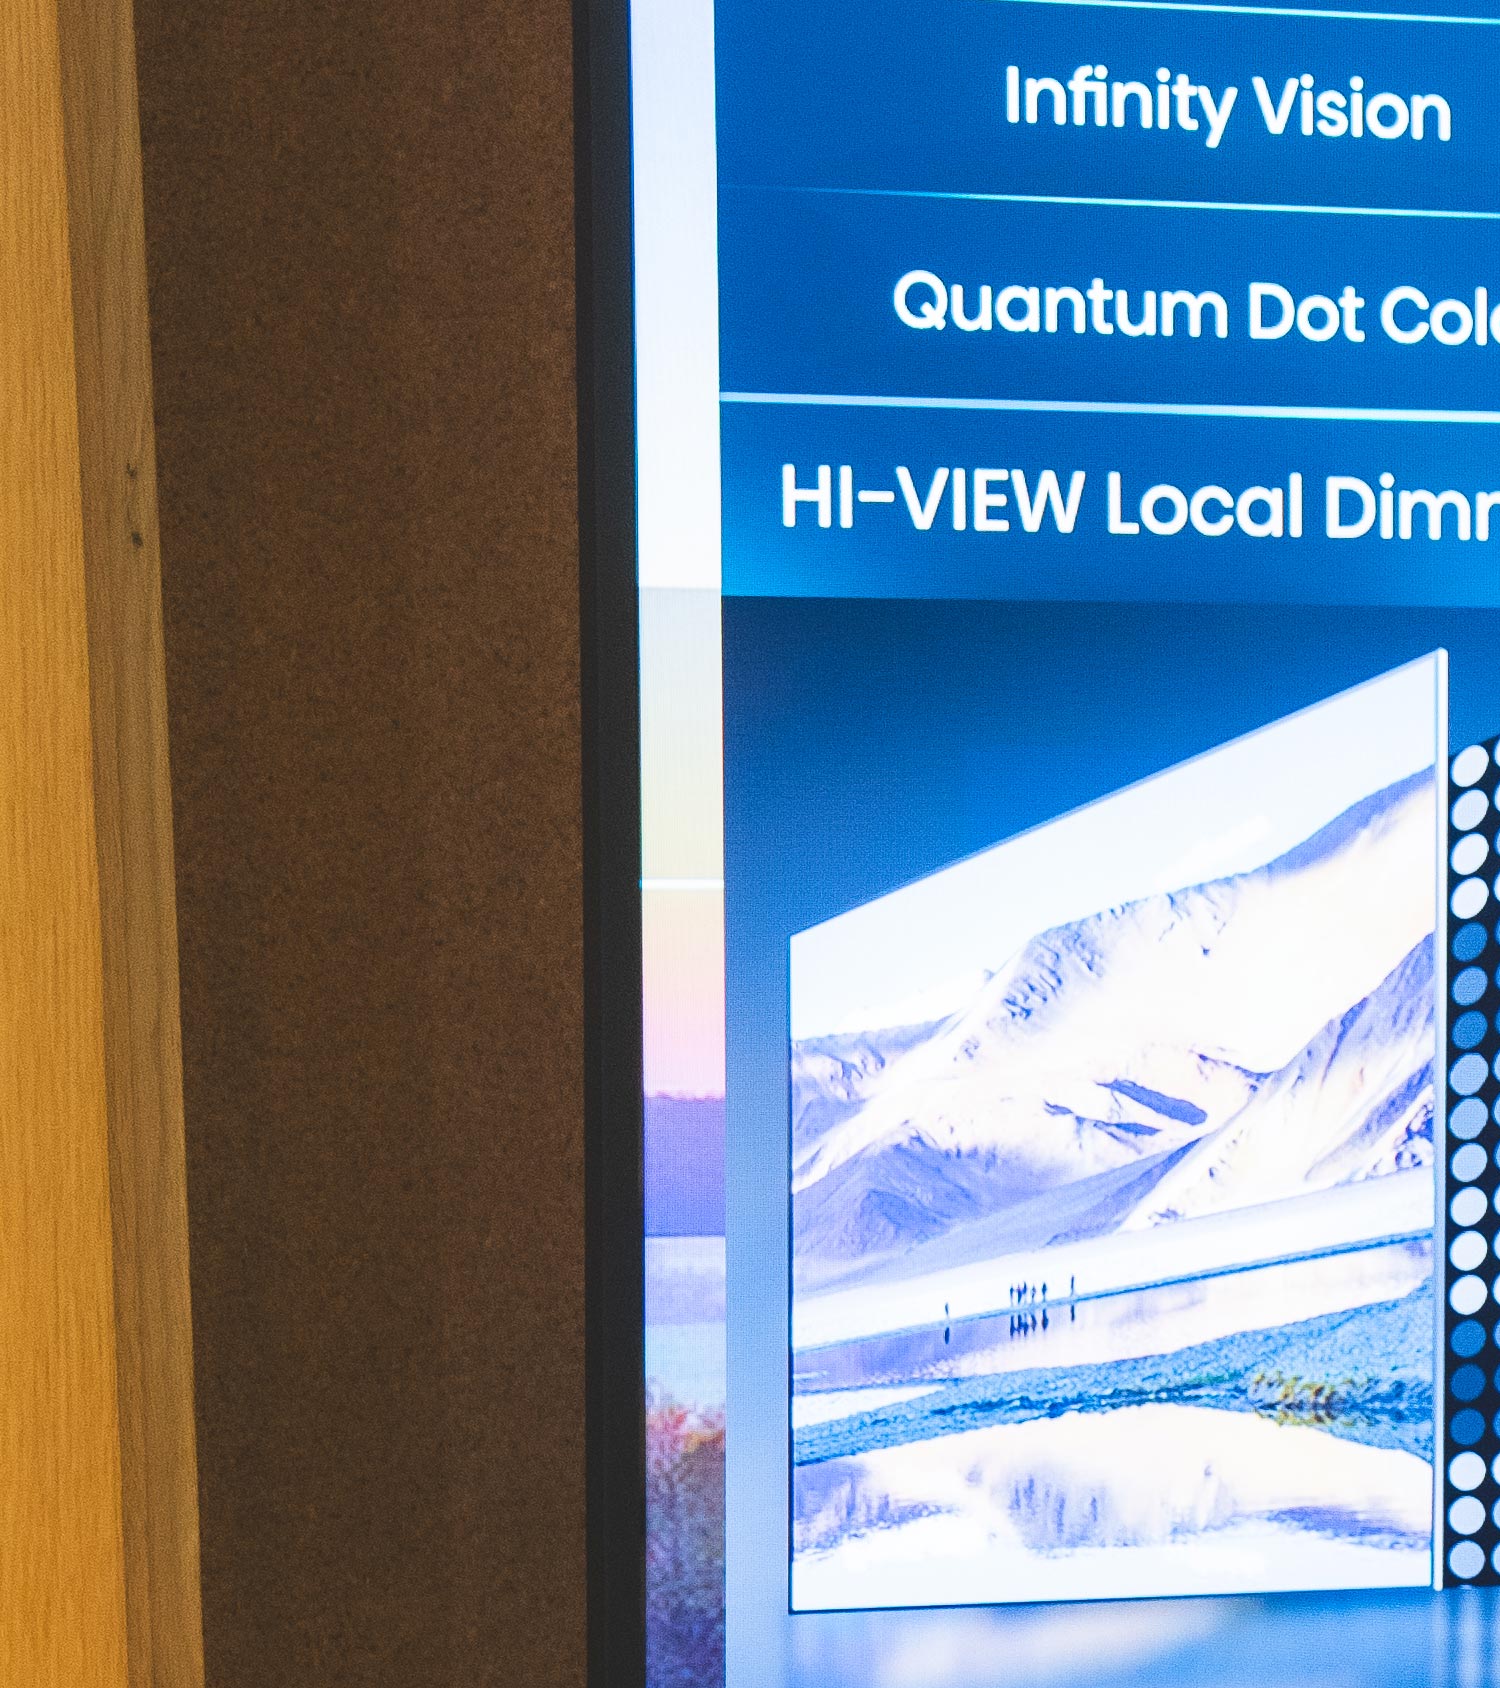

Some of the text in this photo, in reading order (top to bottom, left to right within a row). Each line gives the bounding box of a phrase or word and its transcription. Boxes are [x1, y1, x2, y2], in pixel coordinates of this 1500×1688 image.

[1005, 63, 1453, 149] Infinity Vision
[892, 268, 1229, 340] Quantum
[1248, 281, 1367, 344] Dot
[781, 462, 1087, 535] HI-VIEW
[1106, 469, 1304, 539] Local
